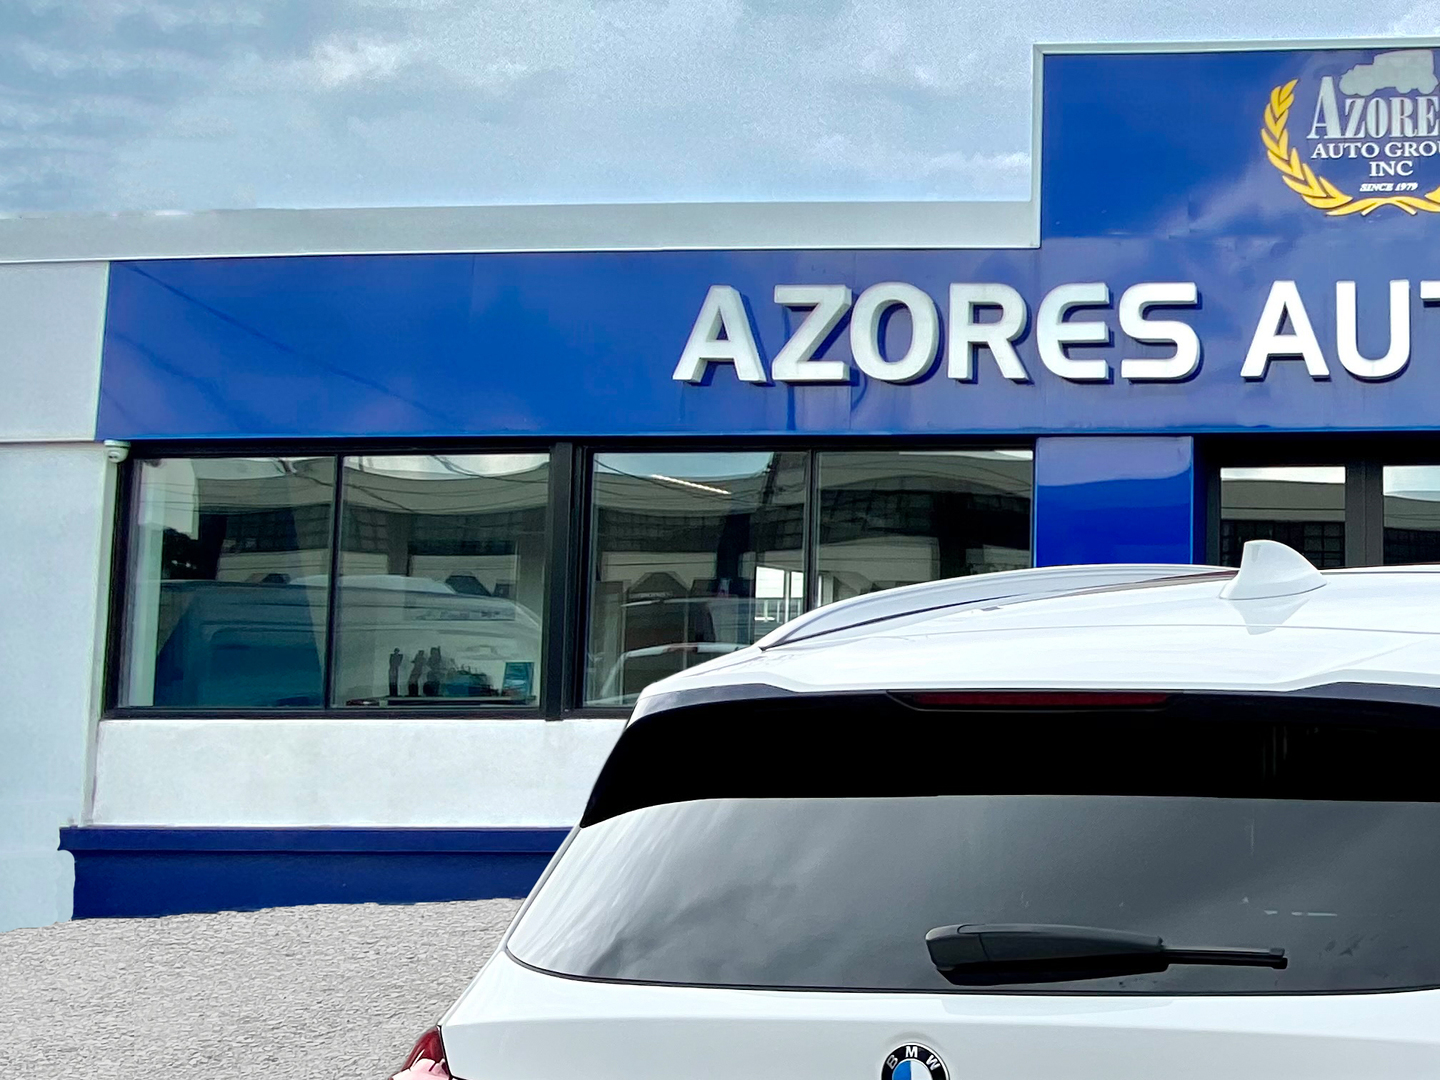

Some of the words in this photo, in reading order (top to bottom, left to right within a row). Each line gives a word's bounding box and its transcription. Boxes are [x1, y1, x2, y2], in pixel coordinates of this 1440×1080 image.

[1311, 142, 1380, 159] AUTO
[1369, 161, 1413, 176] INC
[1359, 182, 1393, 192] SINCE
[1395, 182, 1418, 191] 1979
[672, 281, 1200, 384] AZORES
[886, 1045, 942, 1071] BMW
